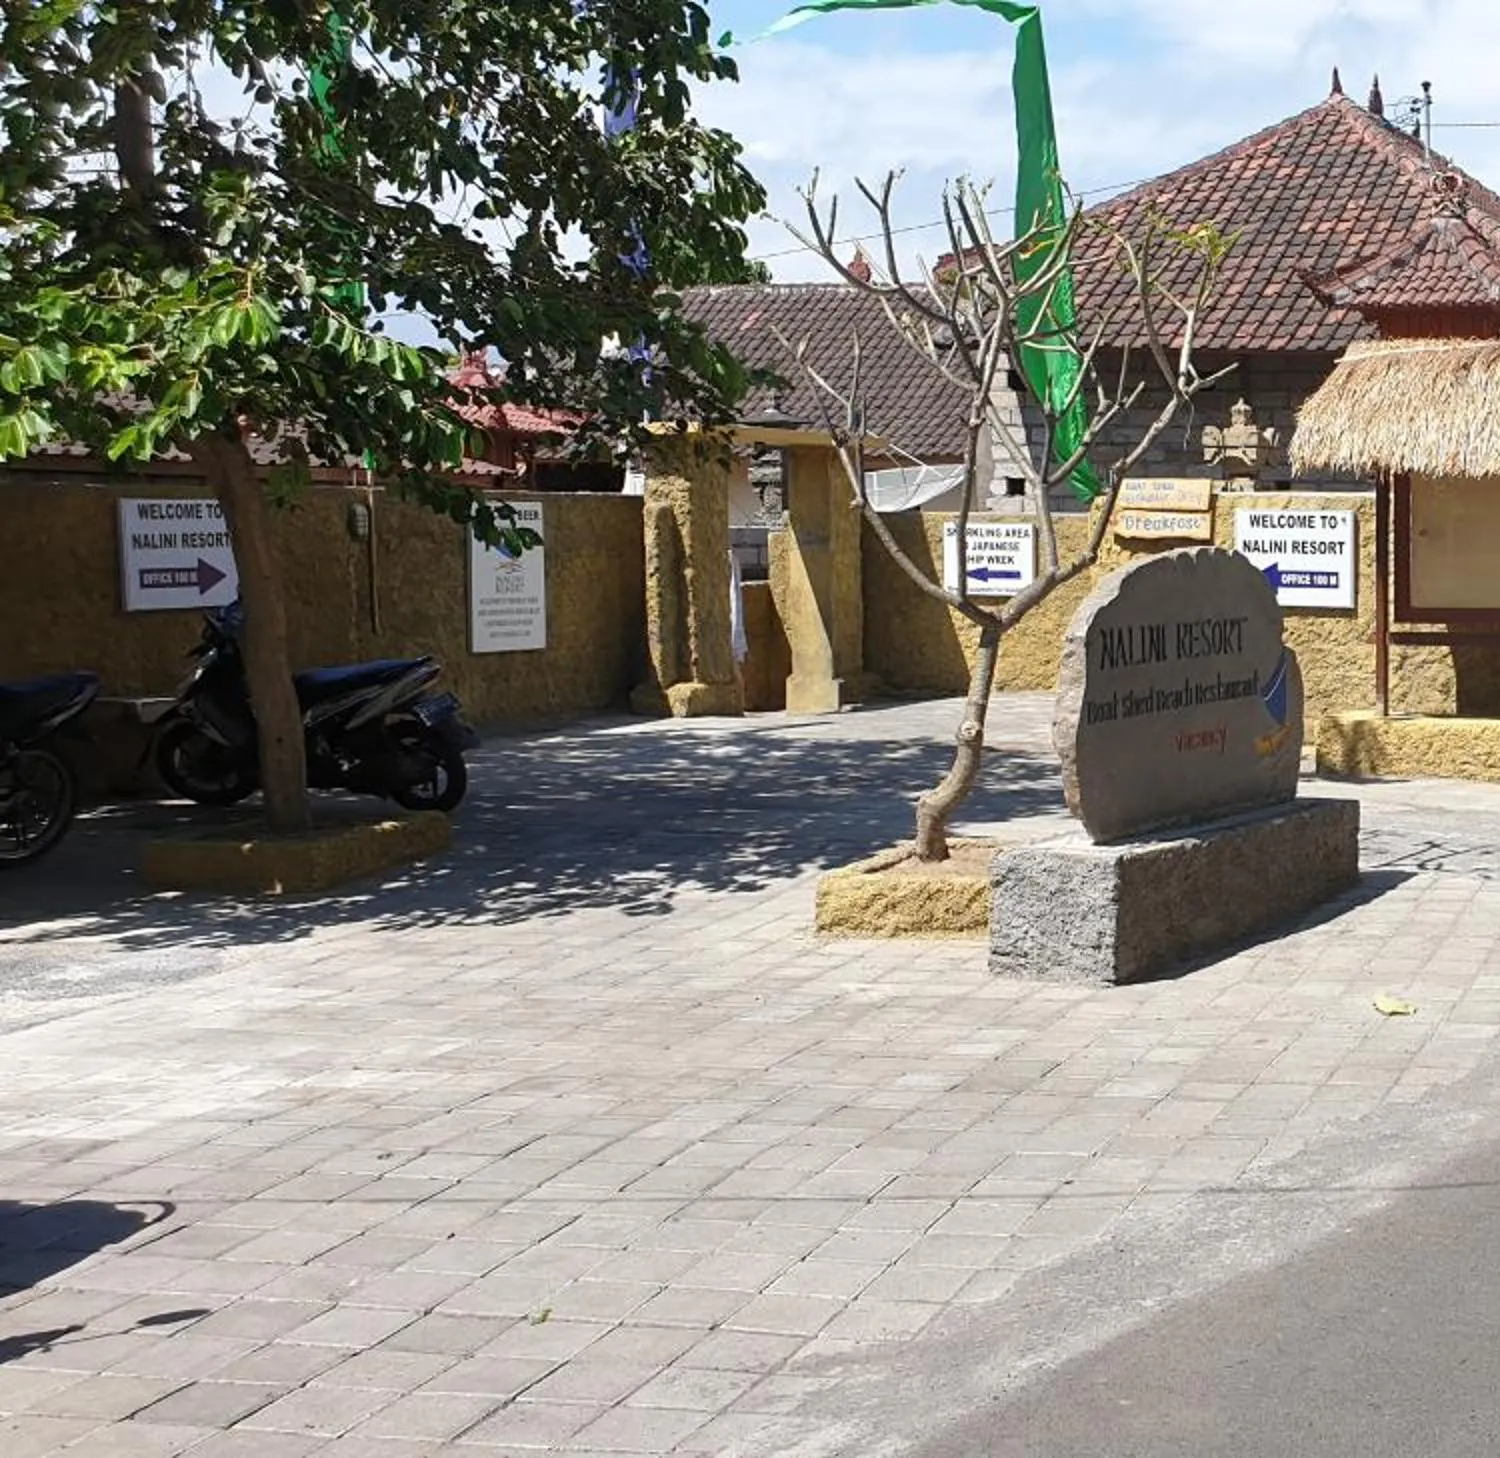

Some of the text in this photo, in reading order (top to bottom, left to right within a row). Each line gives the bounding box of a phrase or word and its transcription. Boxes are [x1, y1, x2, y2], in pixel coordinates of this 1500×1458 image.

[137, 503, 222, 519] WELCOME TO
[517, 509, 539, 521] BEER
[1250, 514, 1338, 529] WELCOME TO
[132, 532, 231, 549] NALINI RESORT
[1004, 528, 1031, 539] AREA
[971, 541, 1020, 551] JAPANESE
[1242, 540, 1345, 555] NALINI RESORT
[1281, 574, 1337, 586] OFFICE 100 M
[1099, 616, 1249, 671] NALINI RESORT
[1085, 690, 1118, 726] Boat
